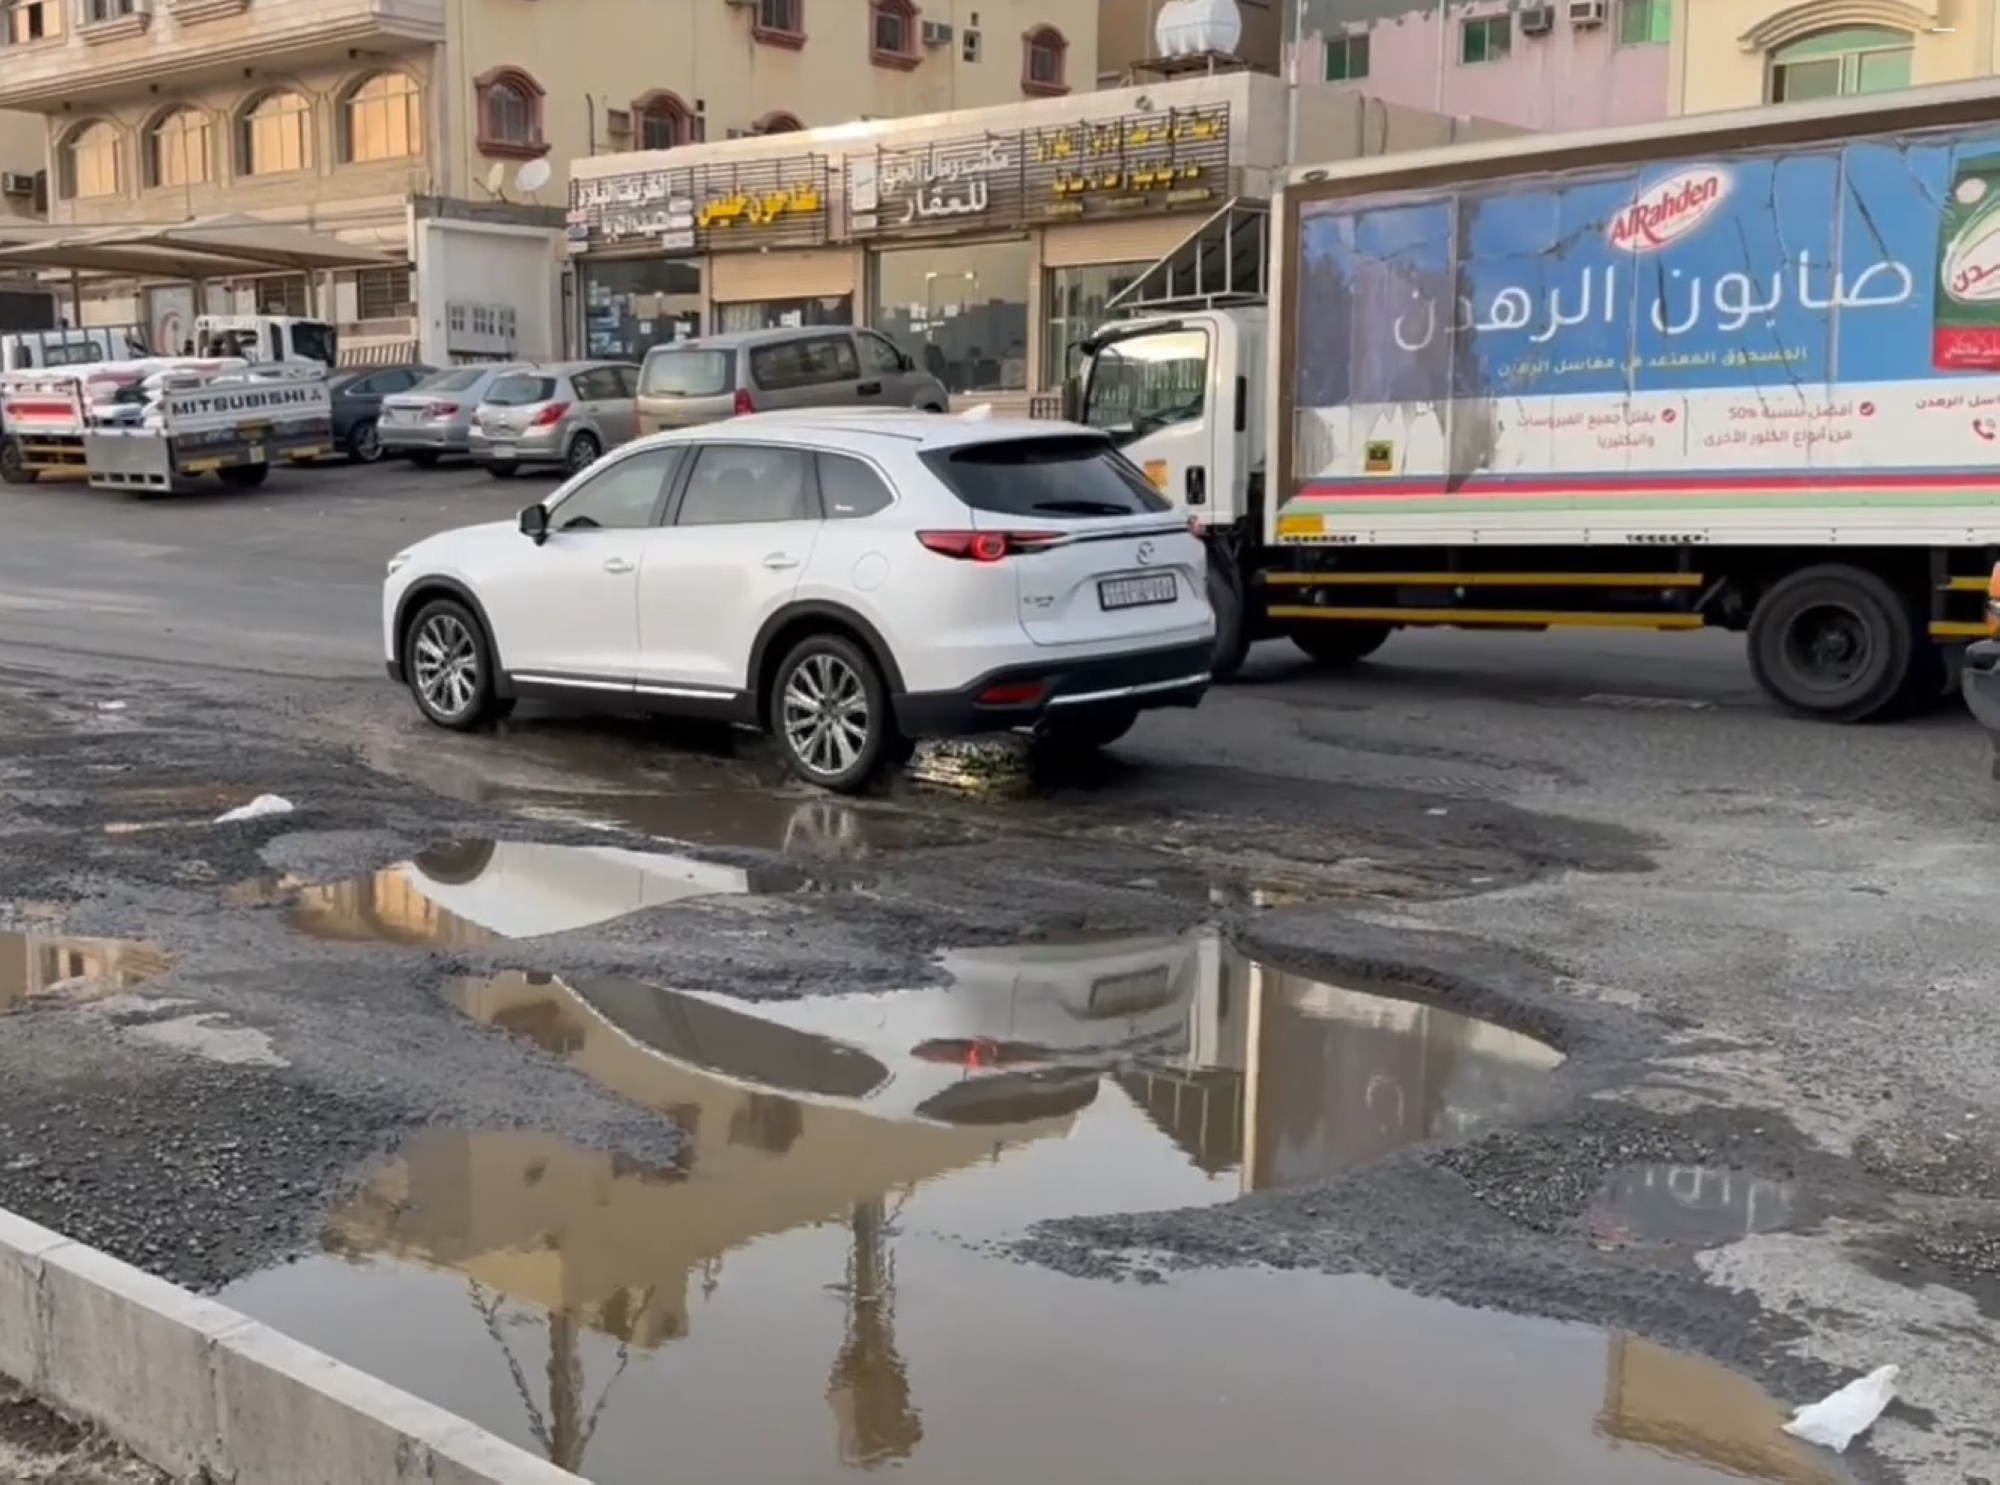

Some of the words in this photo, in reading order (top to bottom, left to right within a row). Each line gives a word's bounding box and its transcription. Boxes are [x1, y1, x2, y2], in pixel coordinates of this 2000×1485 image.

[898, 179, 988, 224] للعقار
[1610, 176, 1718, 246] AlRahden
[1393, 264, 1615, 351] الرهدن
[1650, 248, 1912, 335] صابون
[1646, 350, 1717, 368] المعتمد
[171, 389, 306, 416] MITSUBISHI
